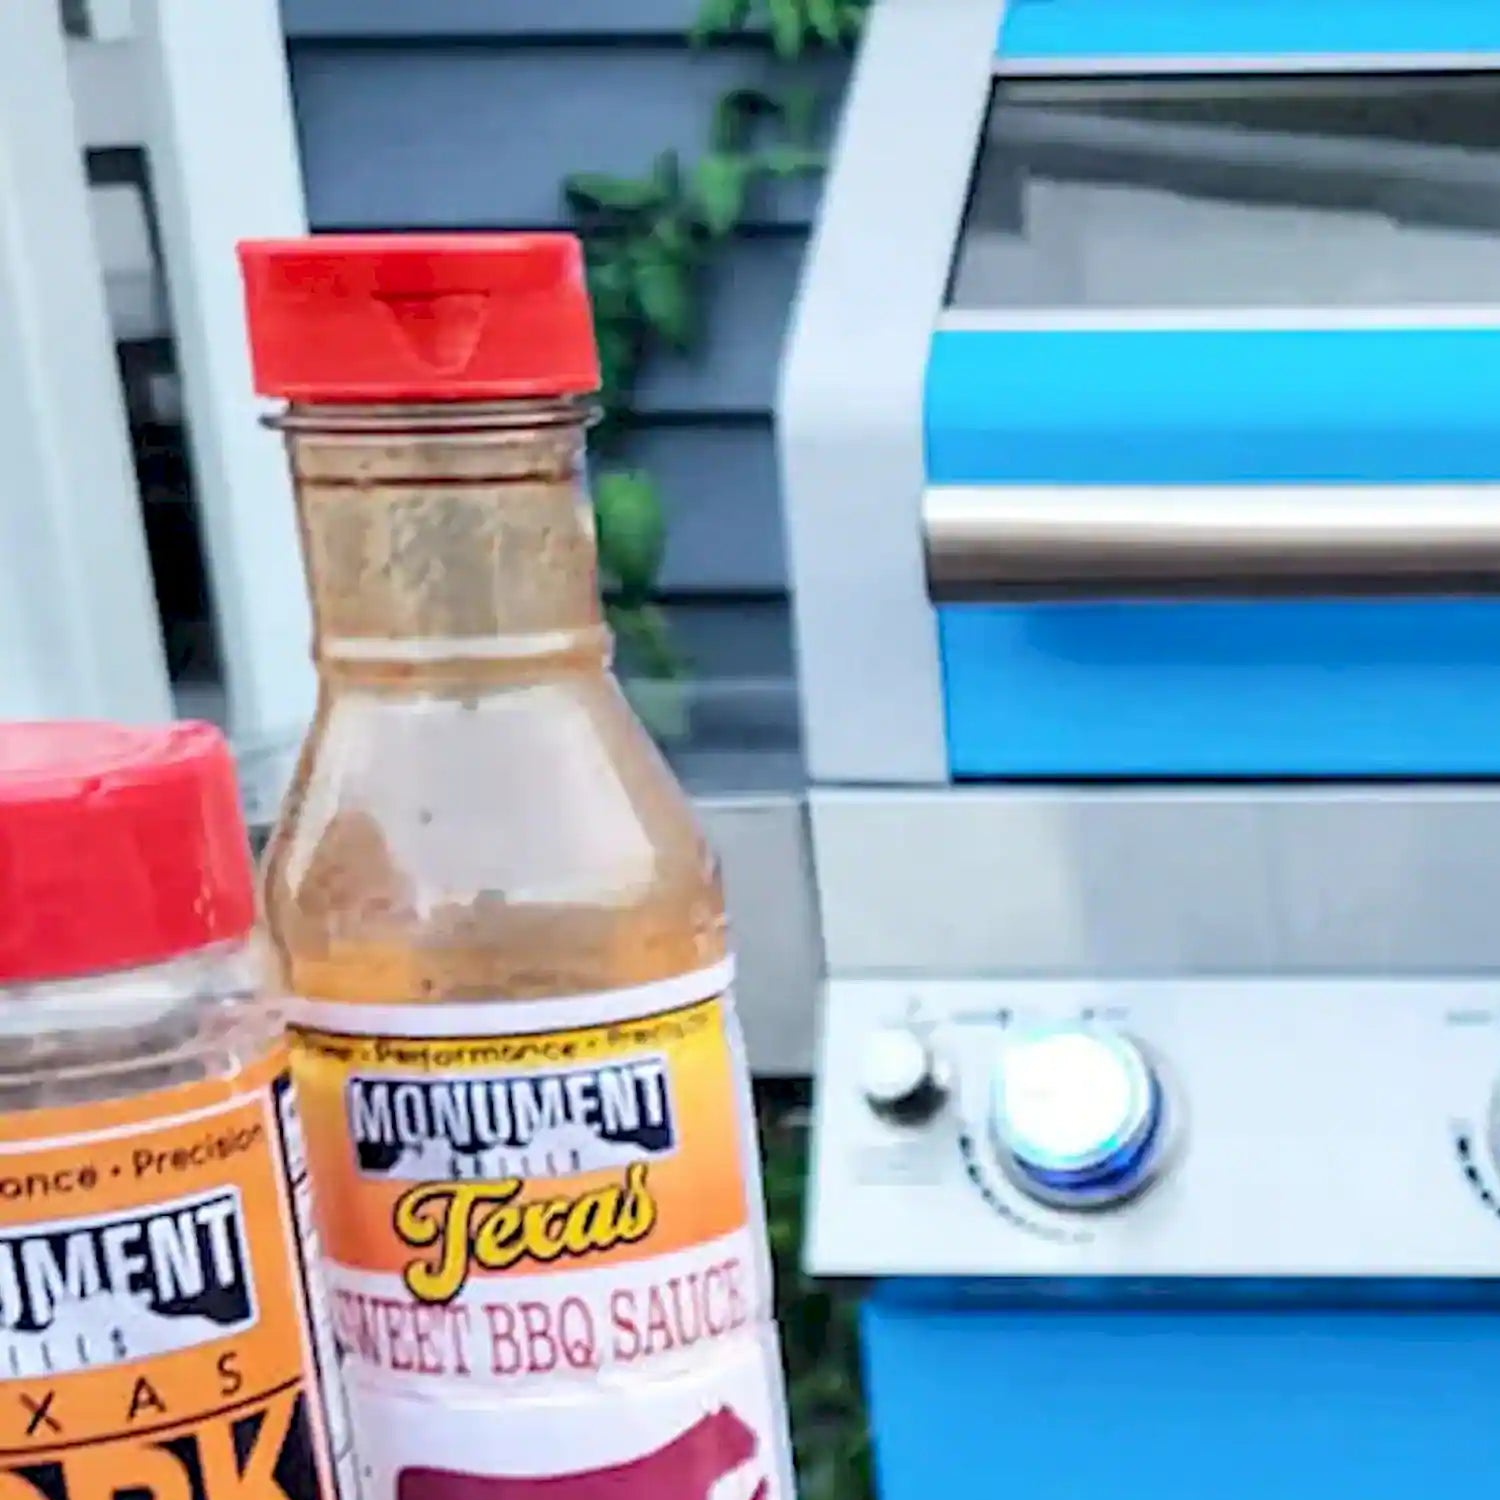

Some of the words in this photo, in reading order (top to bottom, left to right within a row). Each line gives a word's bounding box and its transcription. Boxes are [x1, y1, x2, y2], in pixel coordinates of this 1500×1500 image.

[350, 1063, 666, 1149] MONUMENT
[393, 1161, 657, 1304] Texas
[482, 1297, 597, 1376] BBQ
[610, 1257, 748, 1363] SAUCE
